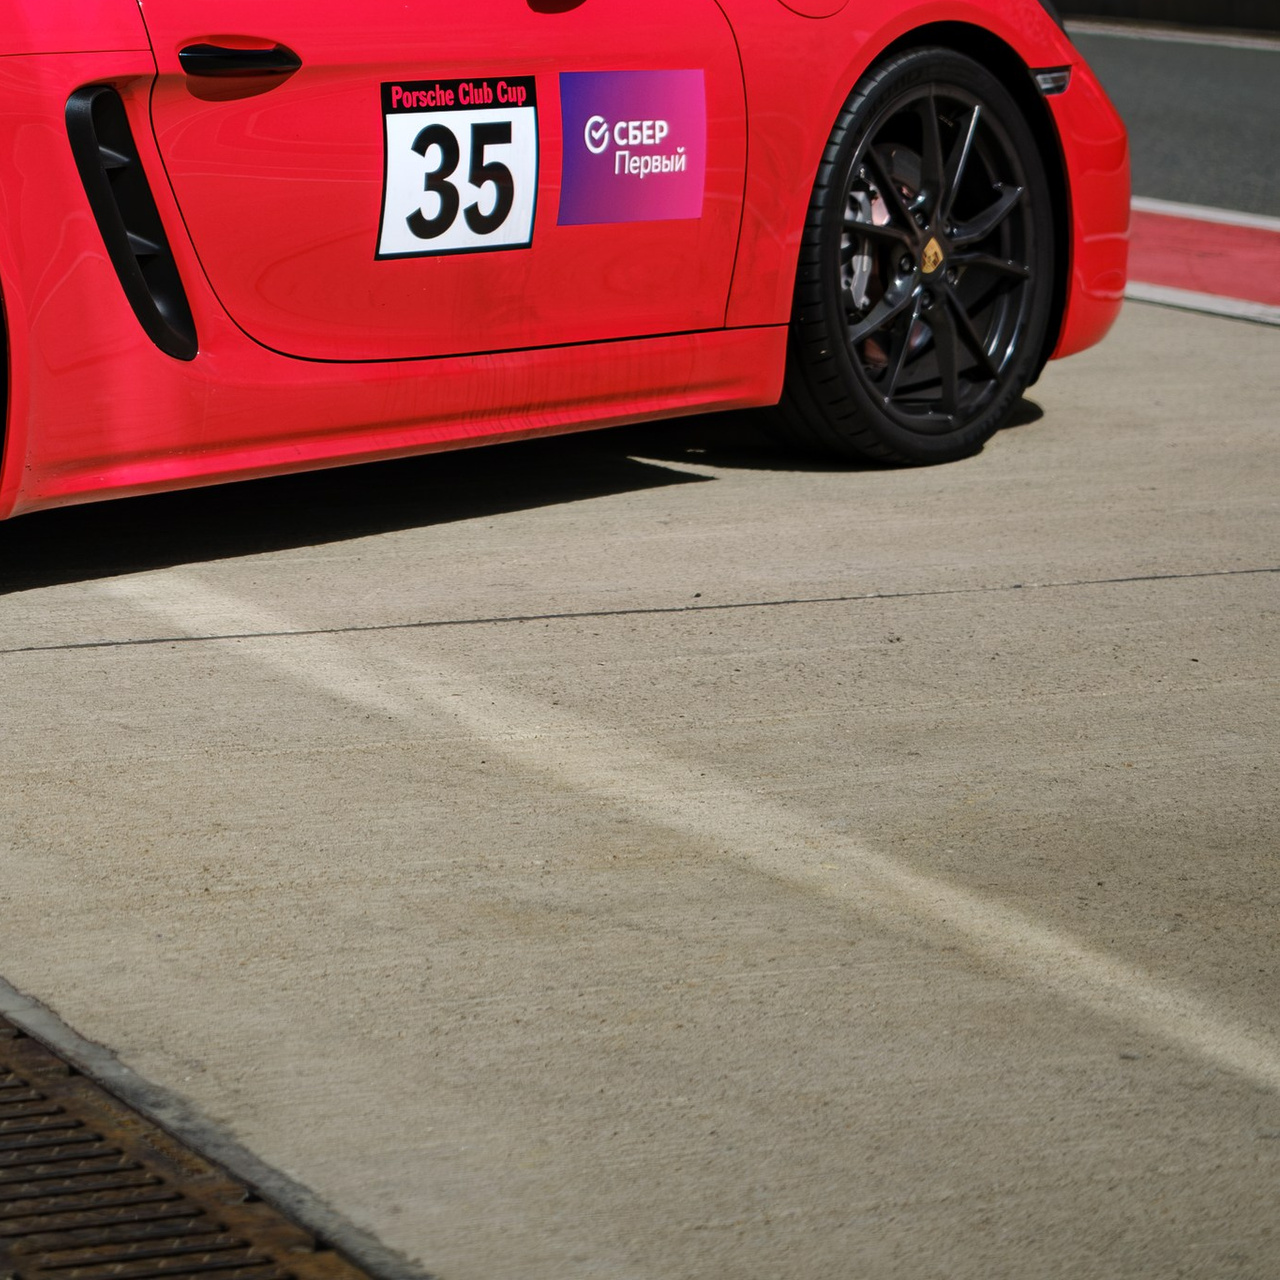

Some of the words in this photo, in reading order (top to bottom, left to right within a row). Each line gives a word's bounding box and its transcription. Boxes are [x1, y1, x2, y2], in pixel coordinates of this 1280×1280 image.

[391, 84, 455, 109] Porsche
[458, 81, 493, 105] Club
[496, 80, 527, 106] Cup
[613, 120, 669, 146] СБЕР
[614, 146, 686, 179] Первый
[405, 120, 515, 240] 35
